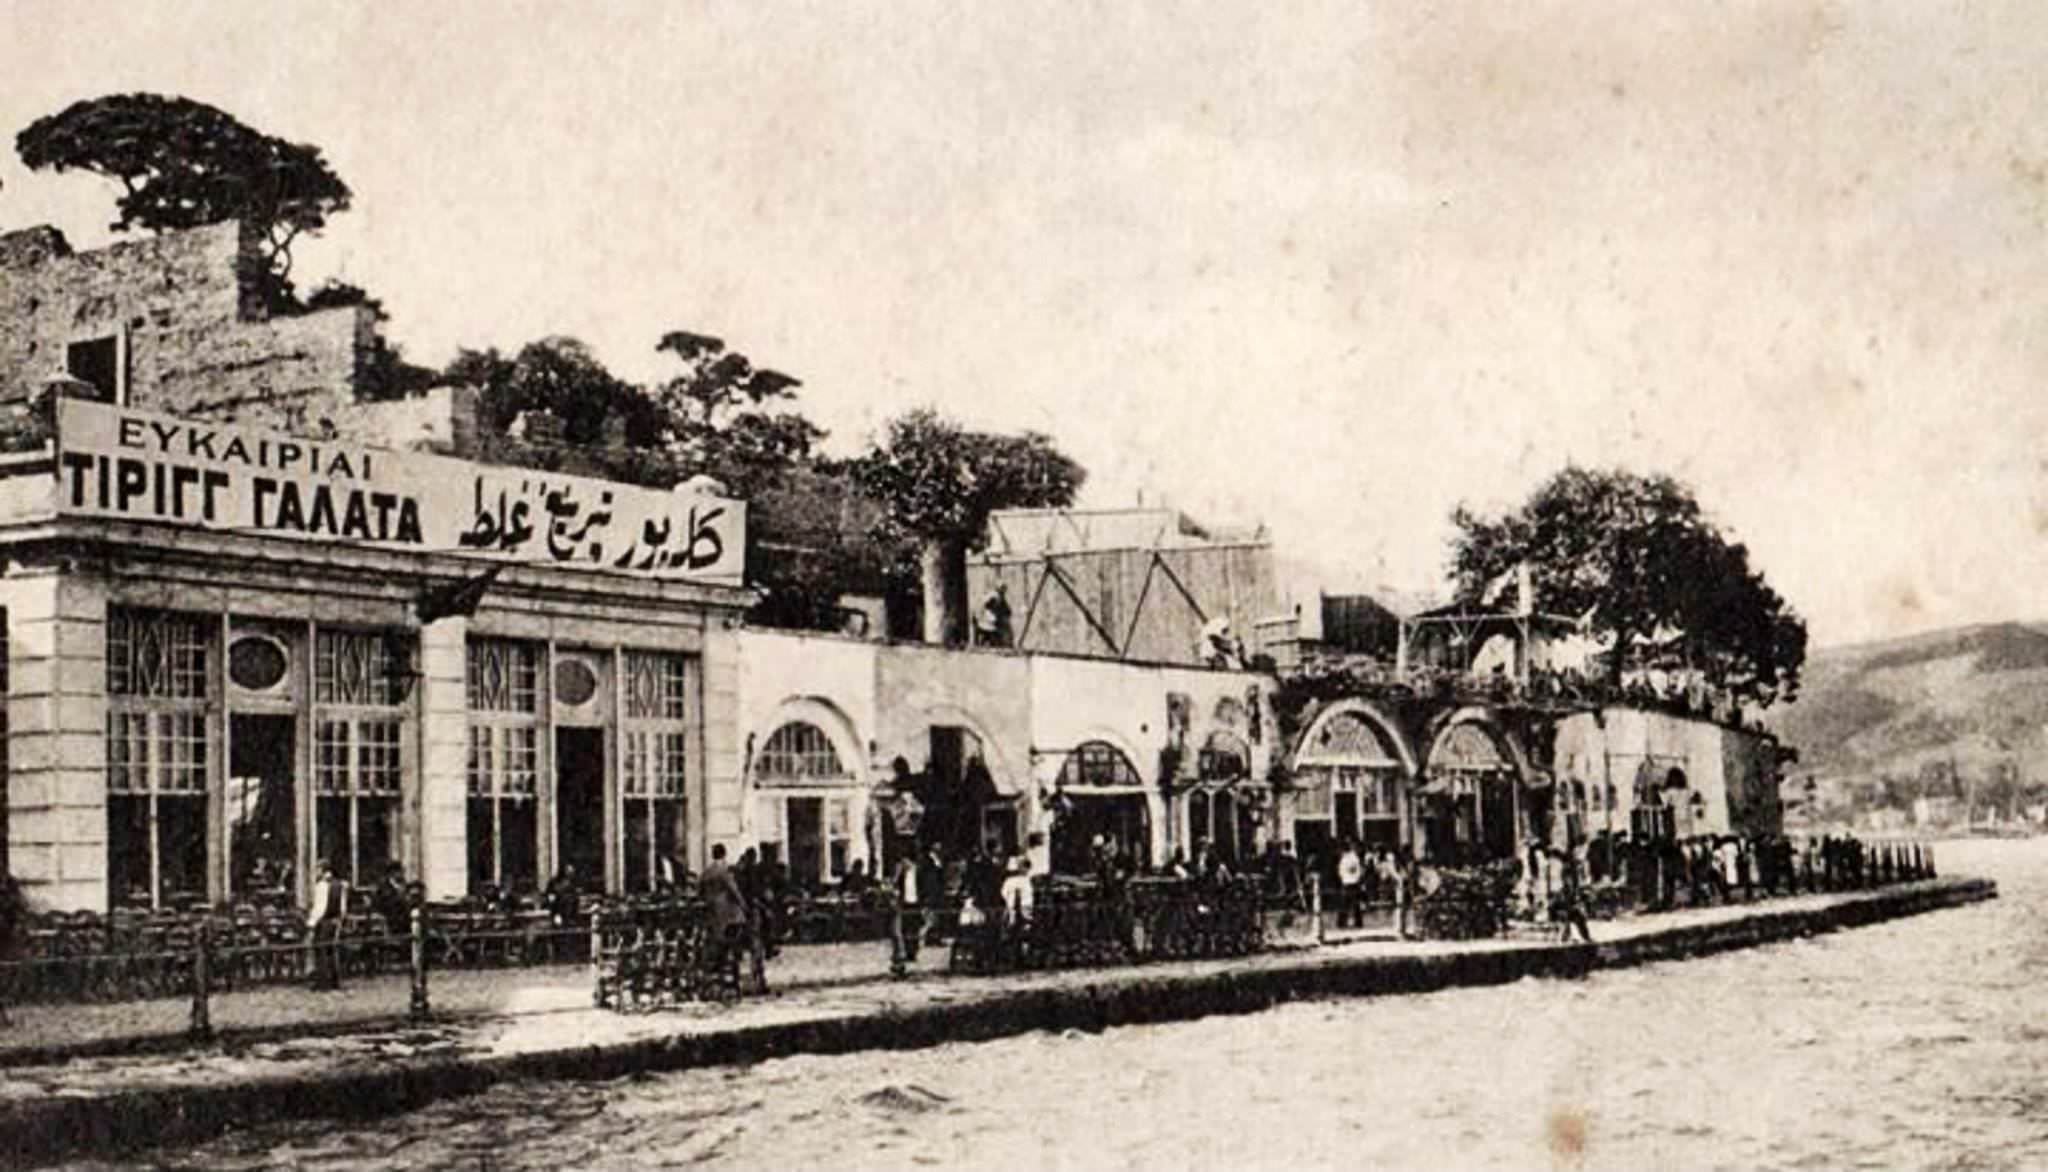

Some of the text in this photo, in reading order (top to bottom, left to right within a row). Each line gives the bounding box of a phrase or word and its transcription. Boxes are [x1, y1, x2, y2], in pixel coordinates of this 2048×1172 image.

[118, 417, 371, 480] ΕΥΚΑΙΡΙΑΙ
[62, 451, 423, 543] ΤΙΡΙΓΓ ΓΑΛΑΤΑ
